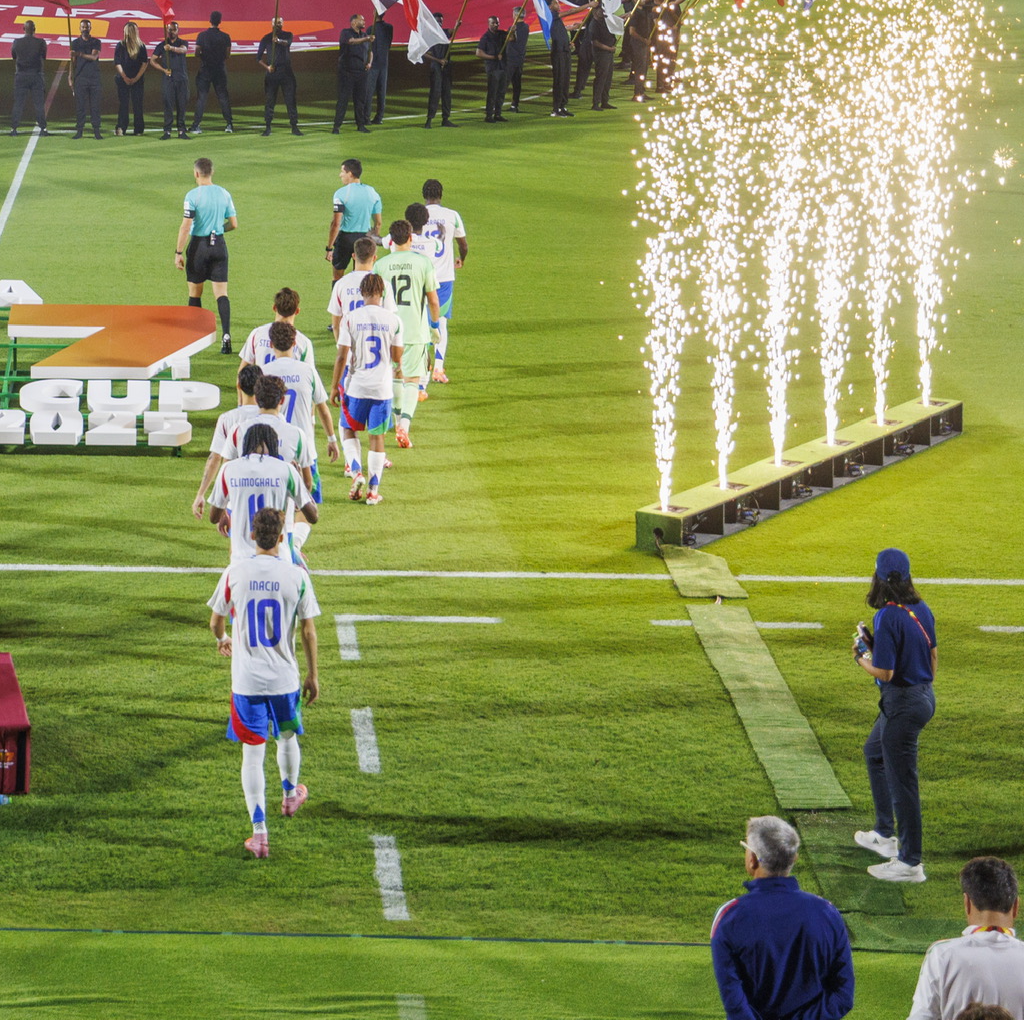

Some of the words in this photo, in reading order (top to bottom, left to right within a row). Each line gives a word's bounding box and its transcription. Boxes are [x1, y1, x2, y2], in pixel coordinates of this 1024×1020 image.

[389, 263, 413, 271] LONGONI
[391, 274, 412, 306] 12
[365, 335, 382, 369] 3
[19, 379, 220, 414] CUP
[230, 477, 280, 488] ELIMOGHALE
[249, 580, 280, 592] INACIO
[247, 598, 282, 648] 10
